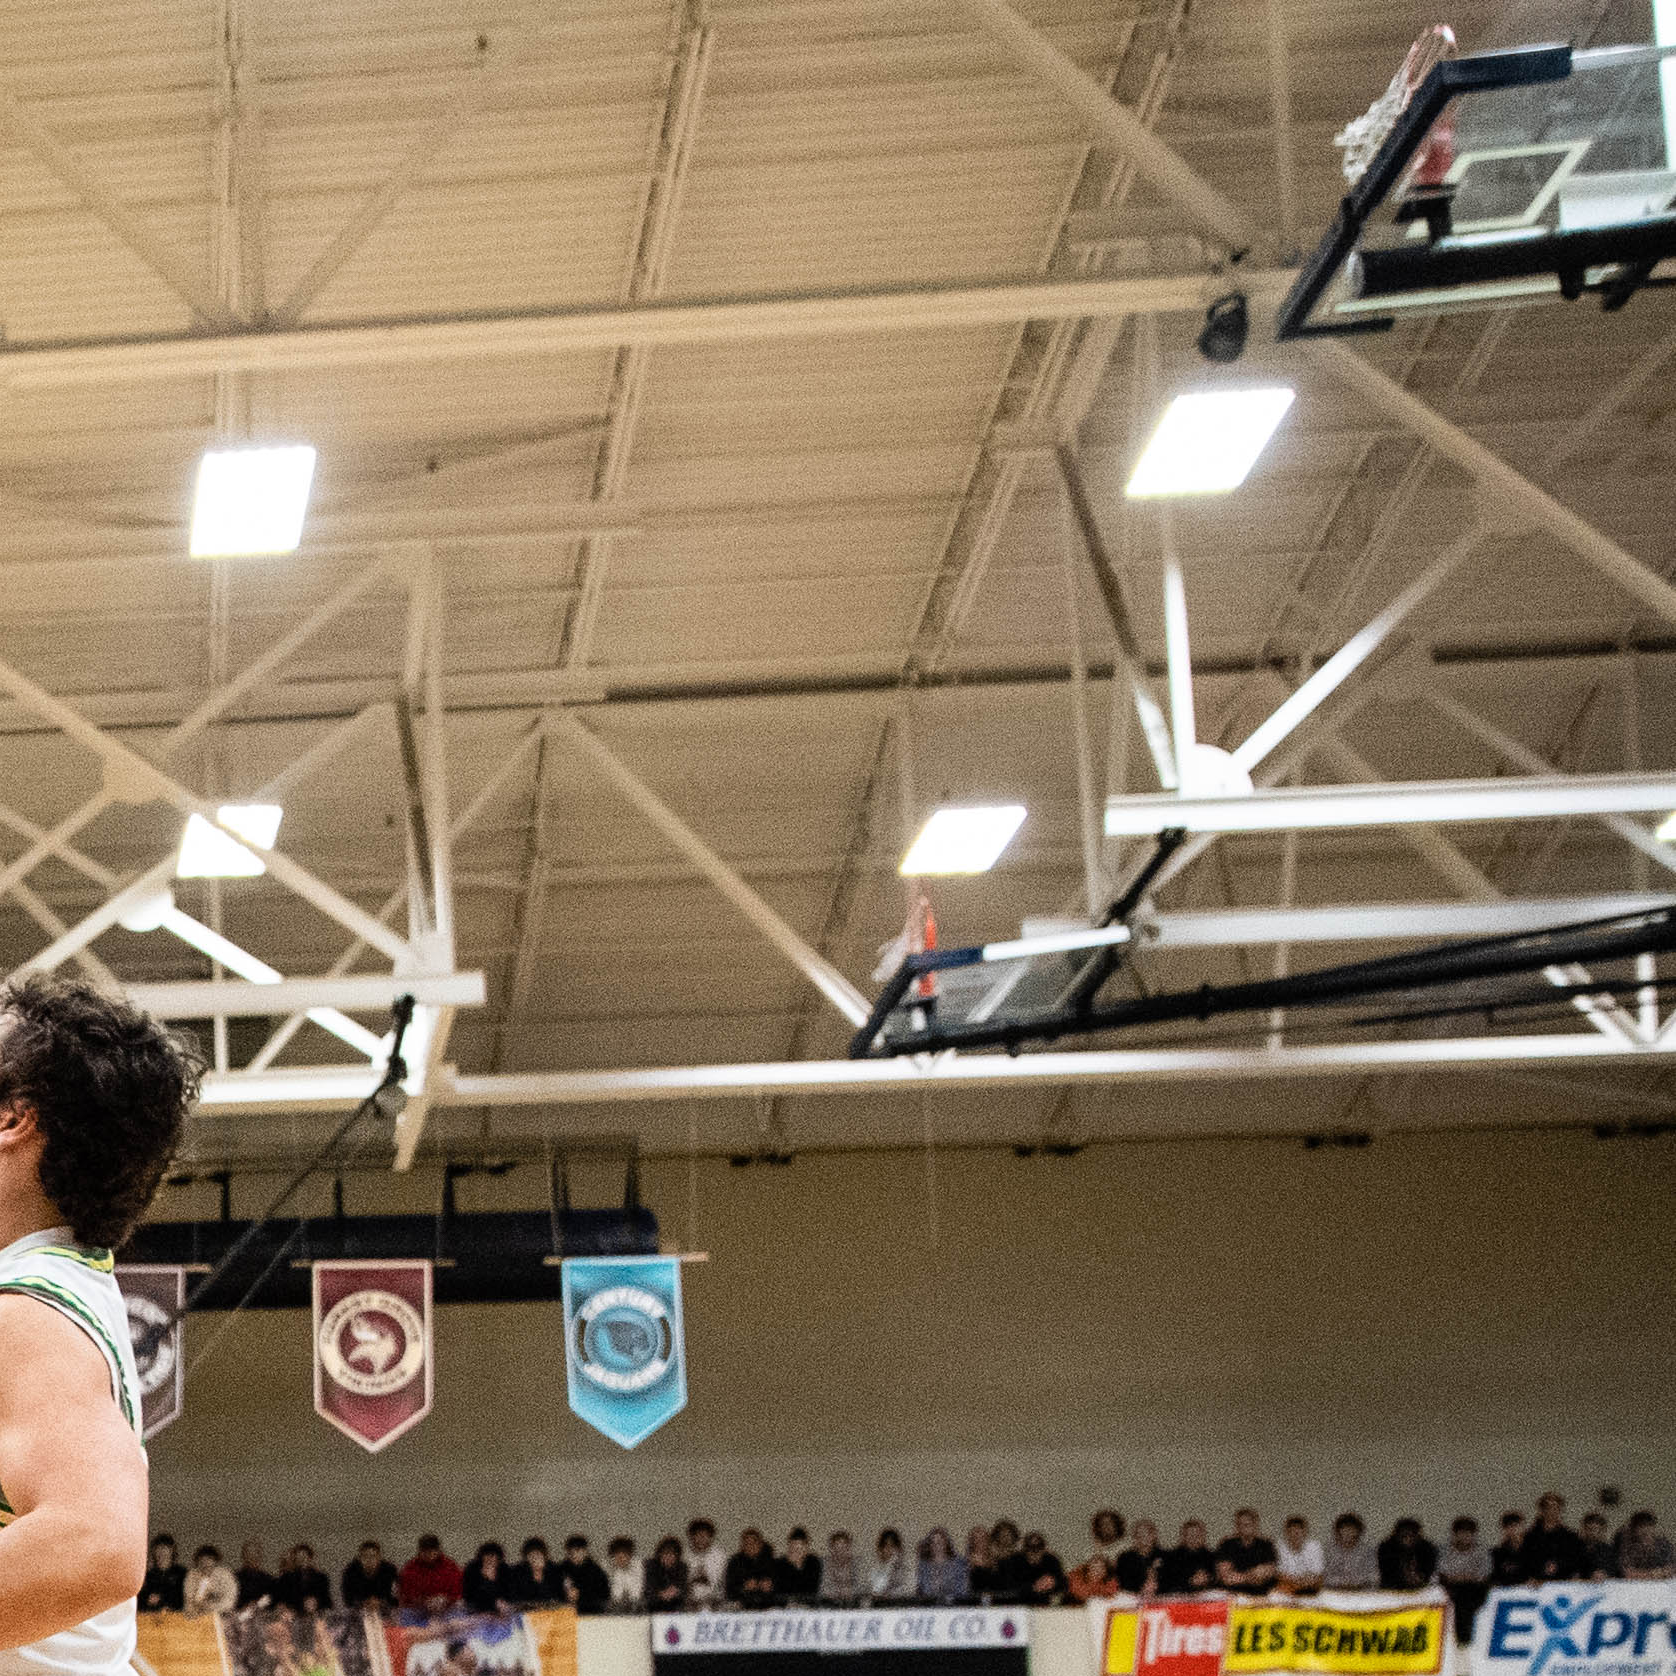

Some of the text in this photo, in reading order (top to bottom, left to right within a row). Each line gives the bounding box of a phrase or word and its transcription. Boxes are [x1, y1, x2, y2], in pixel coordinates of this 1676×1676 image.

[693, 1616, 884, 1645] BRETTHAUER
[894, 1614, 937, 1642] OIL
[1143, 1608, 1429, 1664] Tires LES SCHWAB
